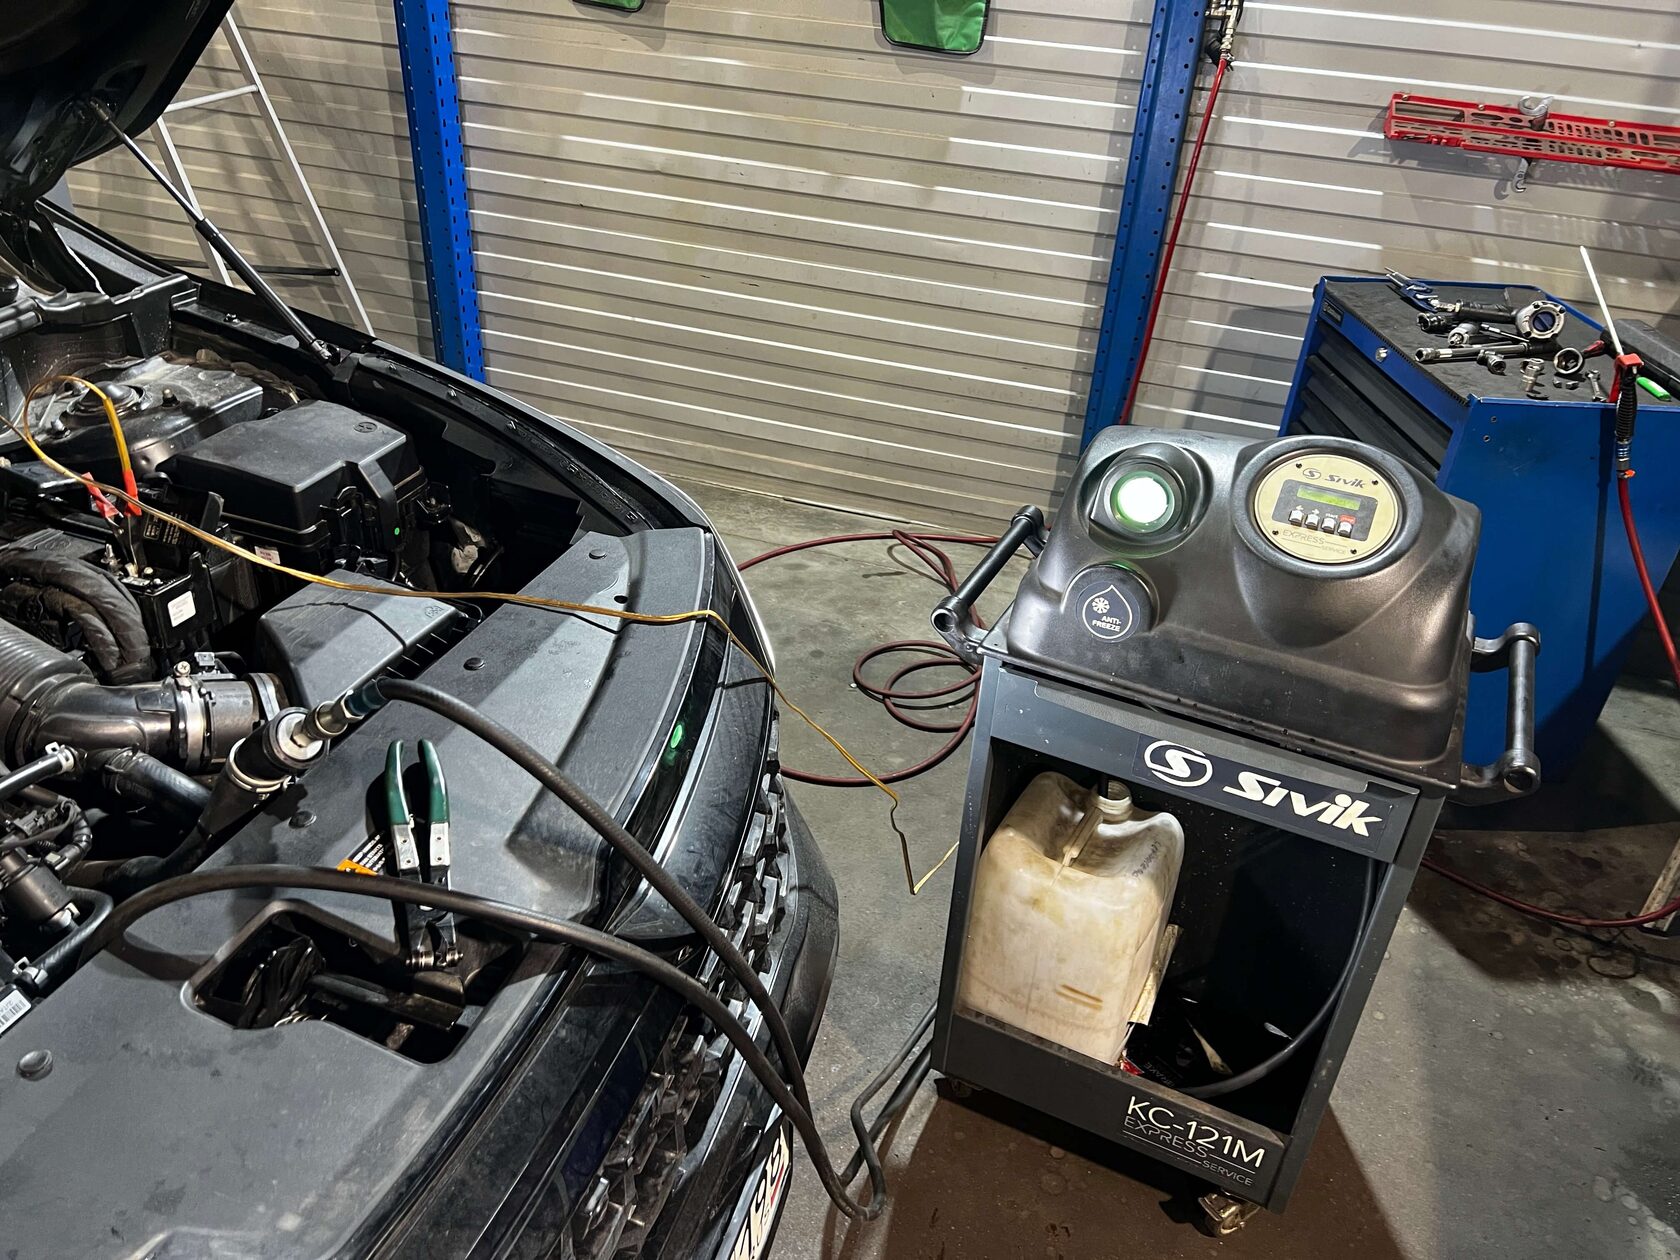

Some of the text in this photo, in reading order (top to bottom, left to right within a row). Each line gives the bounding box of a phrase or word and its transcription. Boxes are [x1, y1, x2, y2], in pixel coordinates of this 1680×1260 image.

[1282, 529, 1326, 545] EXPRESS
[1092, 619, 1121, 632] FREEZE
[1101, 615, 1122, 625] ANTI-
[1124, 1115, 1209, 1158] EXPRESS
[1127, 1095, 1266, 1168] KC-121M
[1202, 1160, 1254, 1186] SERVICE
